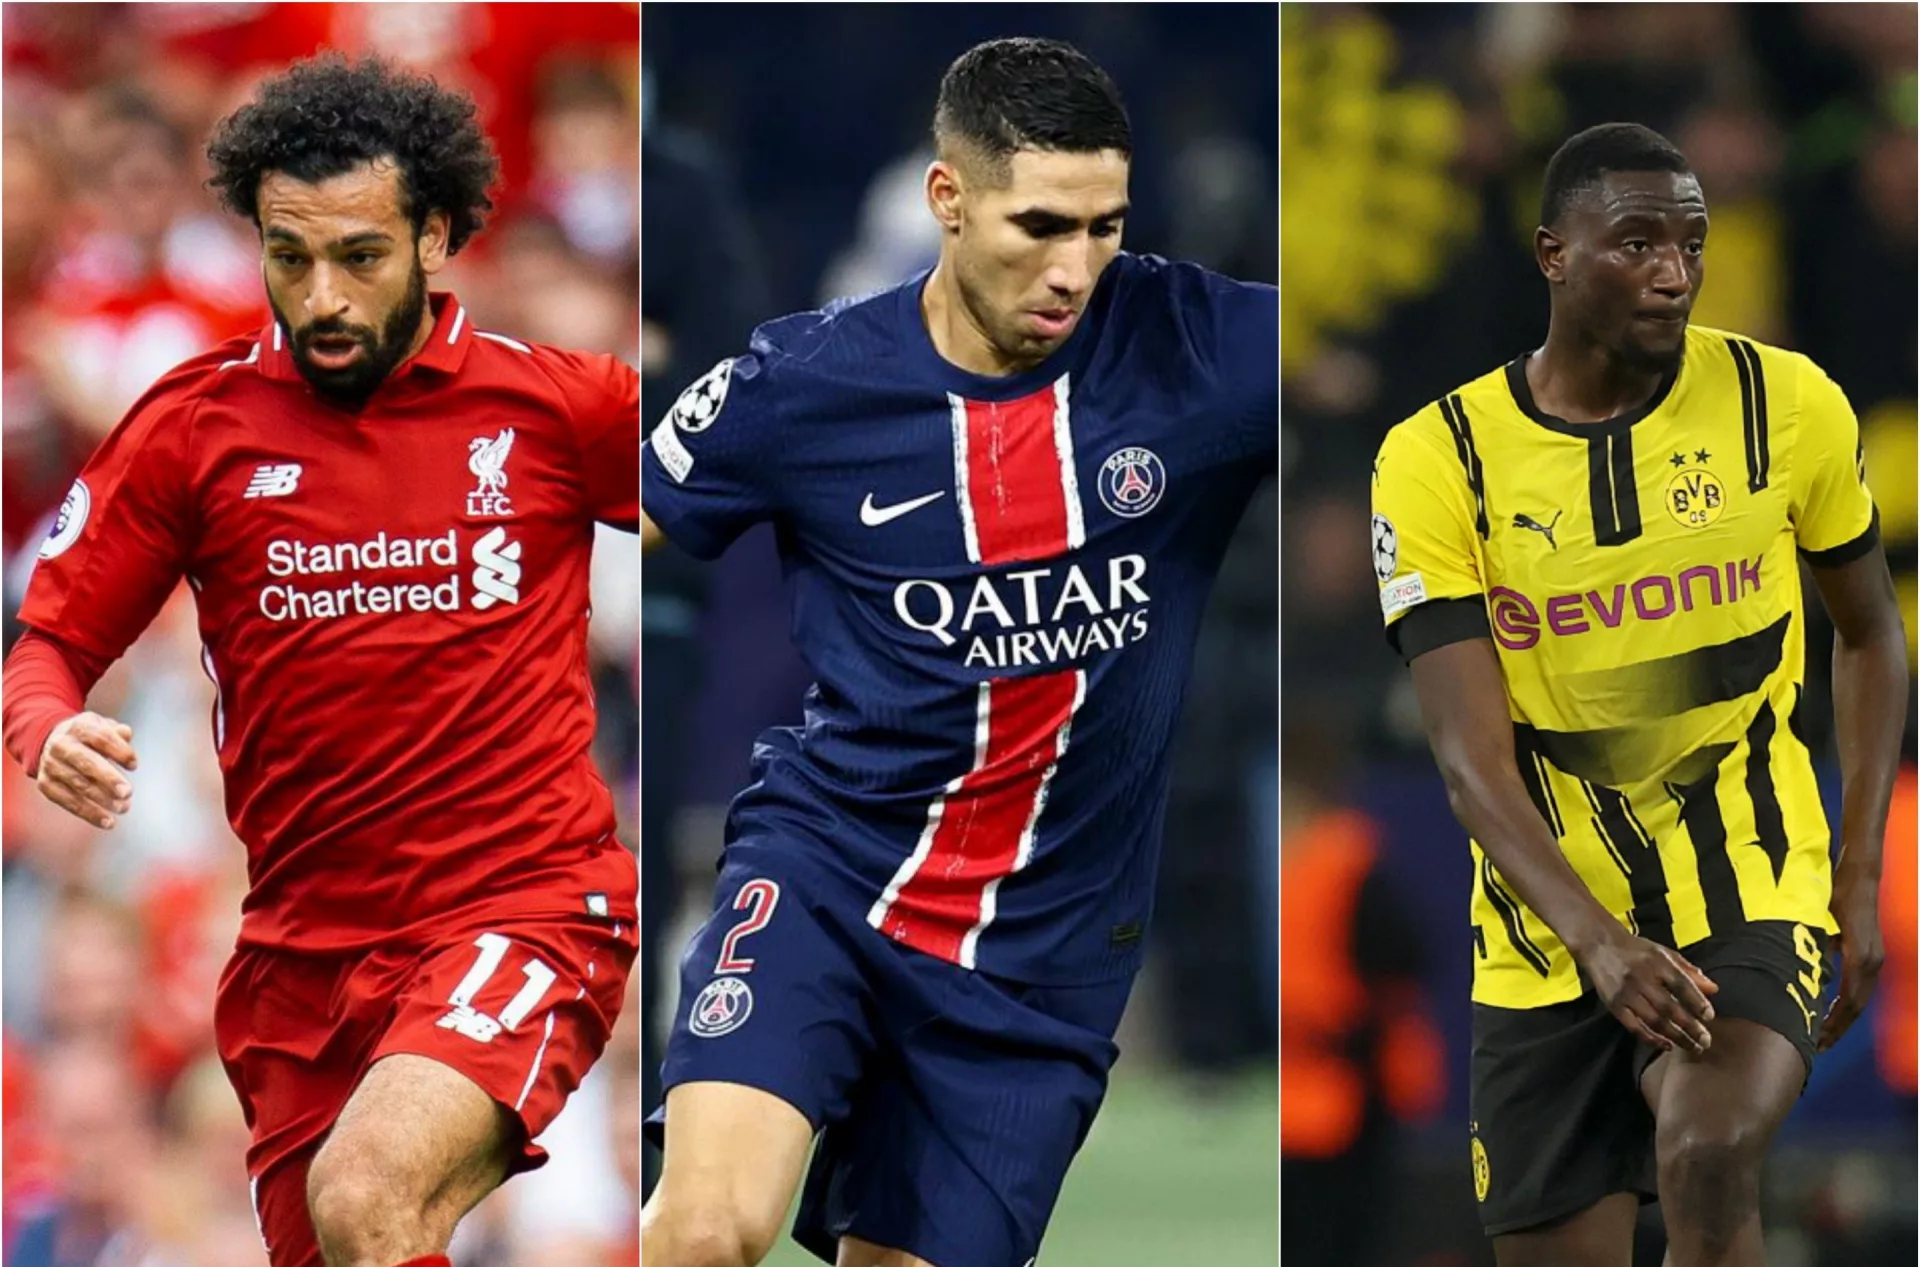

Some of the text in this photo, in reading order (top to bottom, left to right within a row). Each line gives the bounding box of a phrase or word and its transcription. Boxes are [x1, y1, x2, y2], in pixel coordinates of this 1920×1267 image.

[1106, 450, 1151, 471] PARIS
[1672, 473, 1721, 514] BVB
[267, 529, 458, 577] Standard
[259, 574, 460, 622] Chartered
[893, 553, 1151, 647] QATAR
[1546, 552, 1764, 637] EVONIK
[963, 608, 1149, 668] AIRWAYS
[714, 877, 781, 975] 2
[447, 931, 558, 1033] 11
[1792, 922, 1822, 1000] 9
